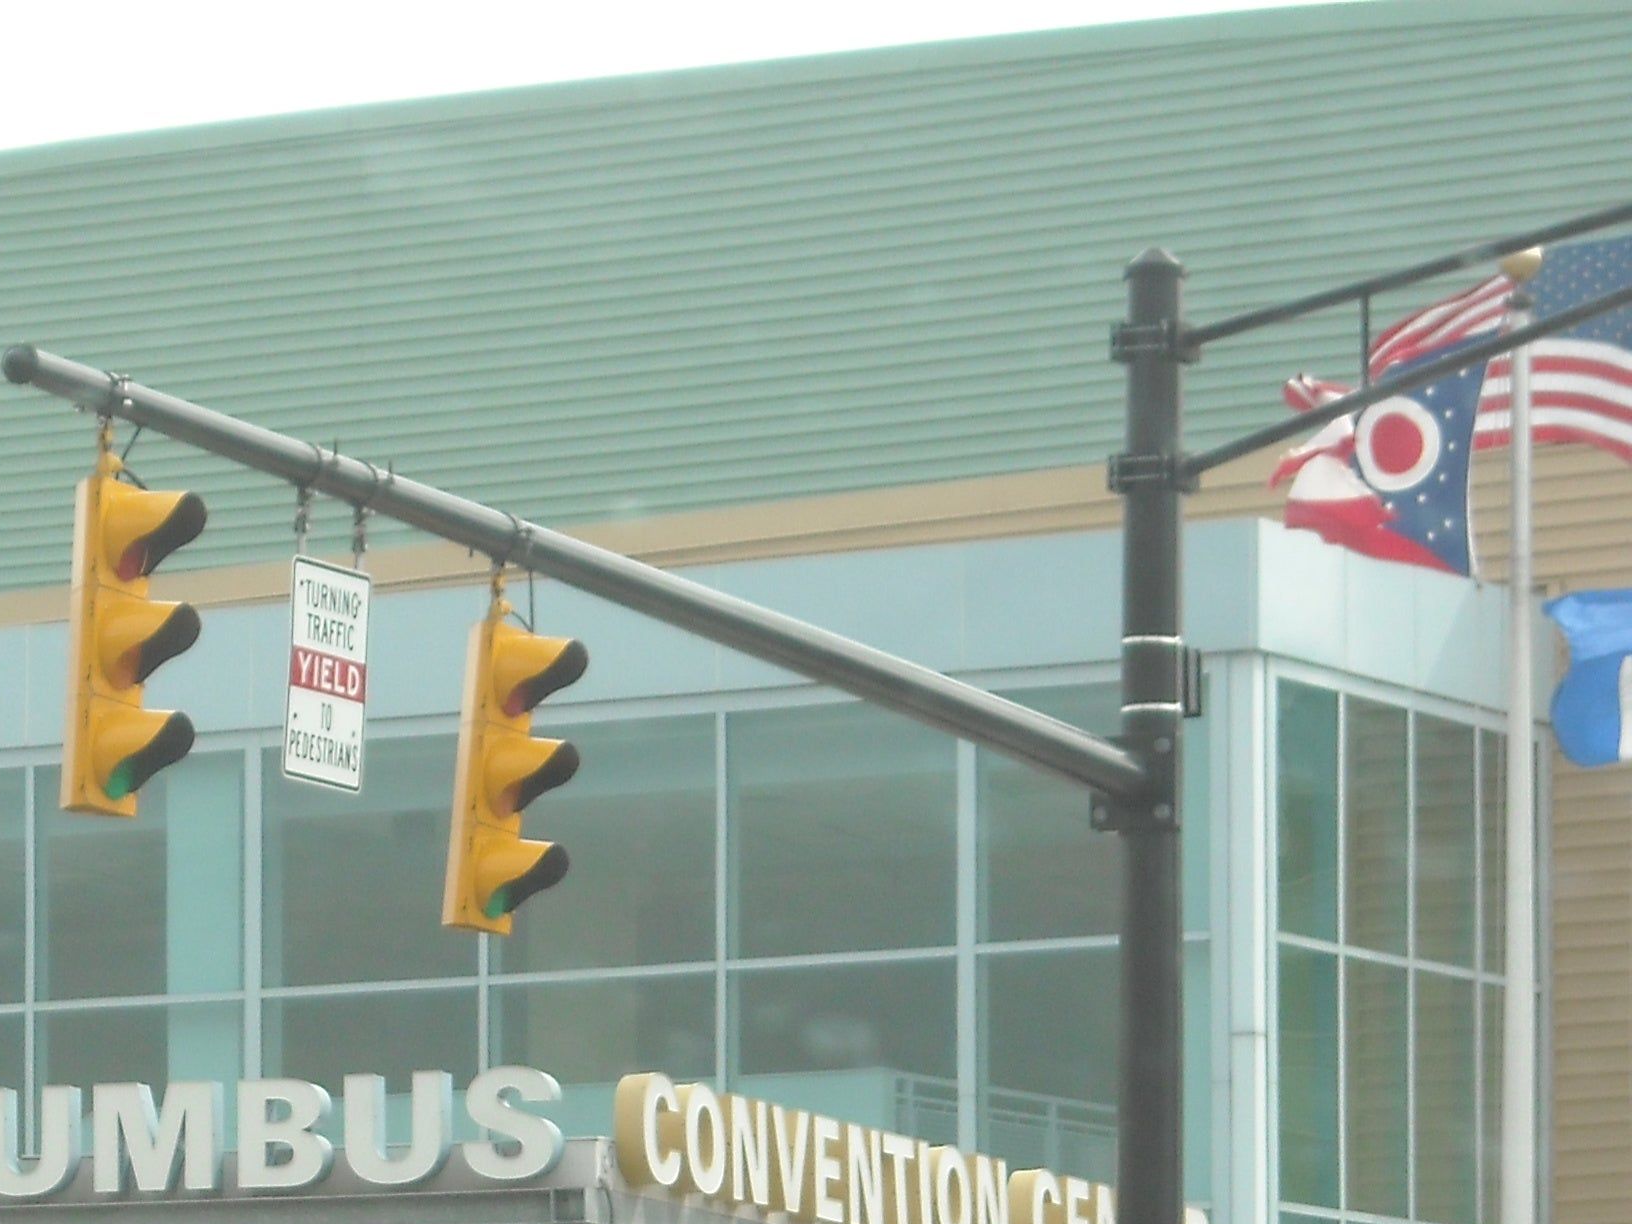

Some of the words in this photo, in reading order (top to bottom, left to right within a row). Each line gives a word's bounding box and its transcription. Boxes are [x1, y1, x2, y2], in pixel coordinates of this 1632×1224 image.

[304, 579, 360, 619] TURNING
[307, 613, 354, 651] TRAFFIC
[298, 651, 360, 697] YIELD
[321, 702, 333, 732] TO
[289, 729, 358, 773] PEDESTRIANS
